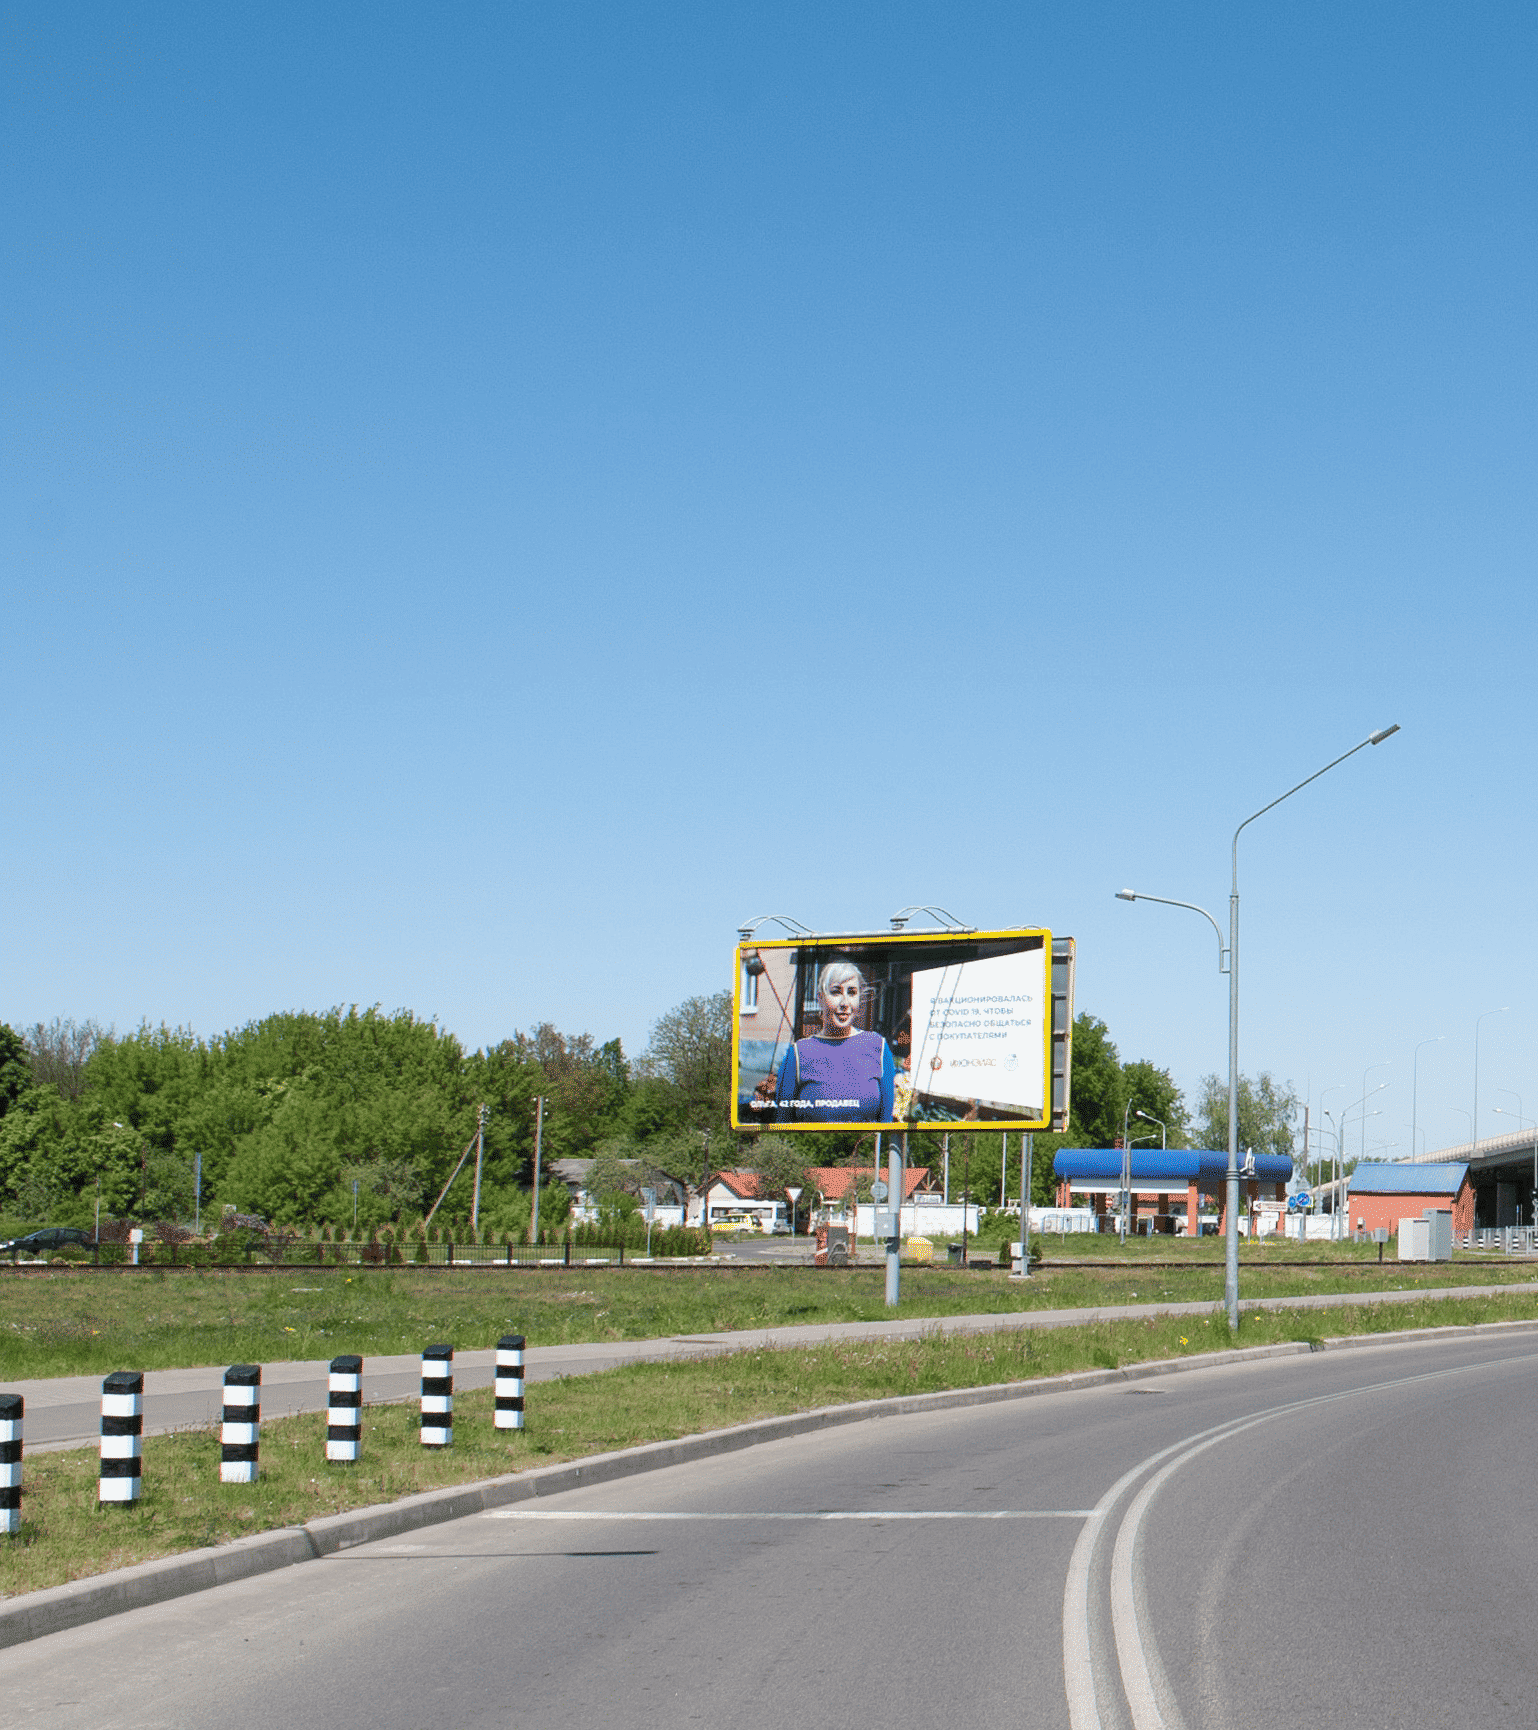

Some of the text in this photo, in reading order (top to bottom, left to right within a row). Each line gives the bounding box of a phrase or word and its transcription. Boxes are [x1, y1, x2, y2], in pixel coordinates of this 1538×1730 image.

[942, 1008, 970, 1016] COVID
[983, 1007, 1014, 1015] ЧТОБЫ
[930, 1019, 1032, 1028] БЕЗОПАСНО ОБЩАТЬСЯ
[937, 1032, 1008, 1040] ПОКУПАТЕЛЯМИ
[815, 1099, 860, 1108] ПРОДАВЕЦ
